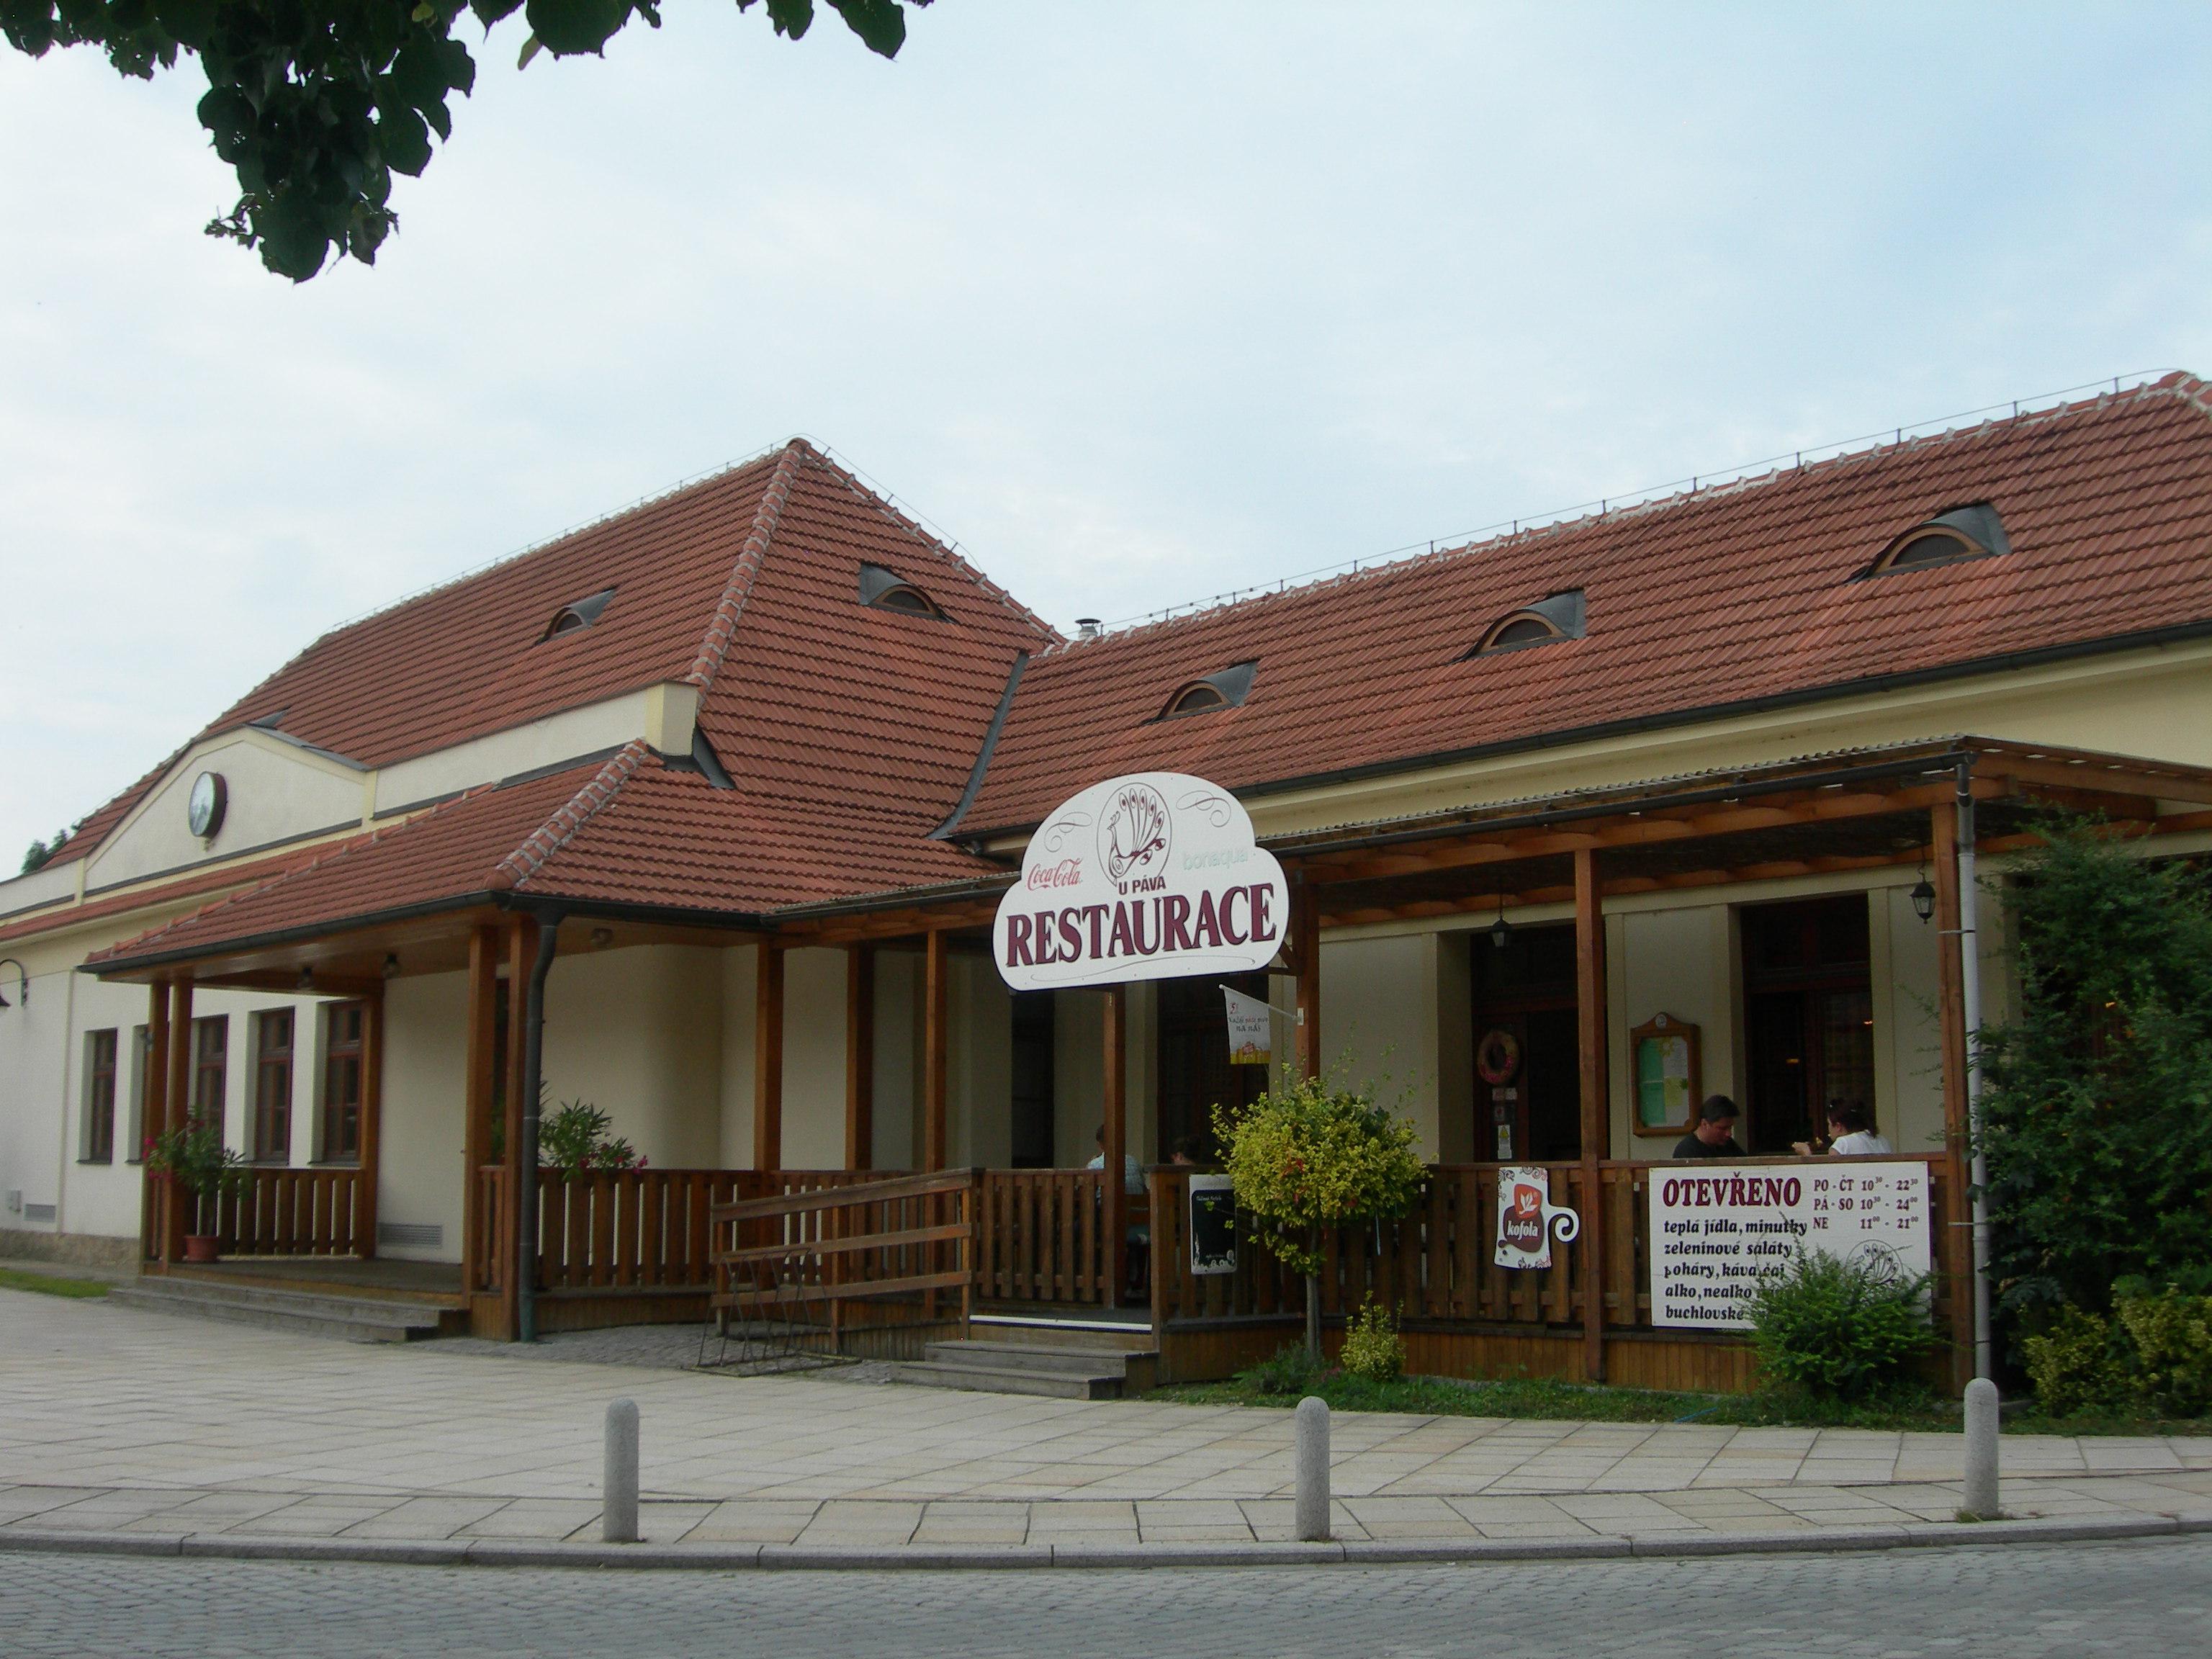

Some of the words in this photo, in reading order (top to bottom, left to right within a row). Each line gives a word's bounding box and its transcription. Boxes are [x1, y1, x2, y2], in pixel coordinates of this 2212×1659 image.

[1119, 881, 1128, 895] U
[1132, 874, 1166, 894] PÁVA
[1006, 883, 1277, 967] RESTAURACE
[1663, 1171, 1802, 1207] OTEVŘENO
[1506, 1220, 1539, 1241] kofola
[1664, 1219, 1699, 1236] teplá
[1745, 1219, 1807, 1236] minutky
[1812, 1217, 1829, 1229] NE
[1664, 1241, 1741, 1254] zeleninové
[1746, 1241, 1792, 1258] saláty
[1704, 1284, 1752, 1298] nealko
